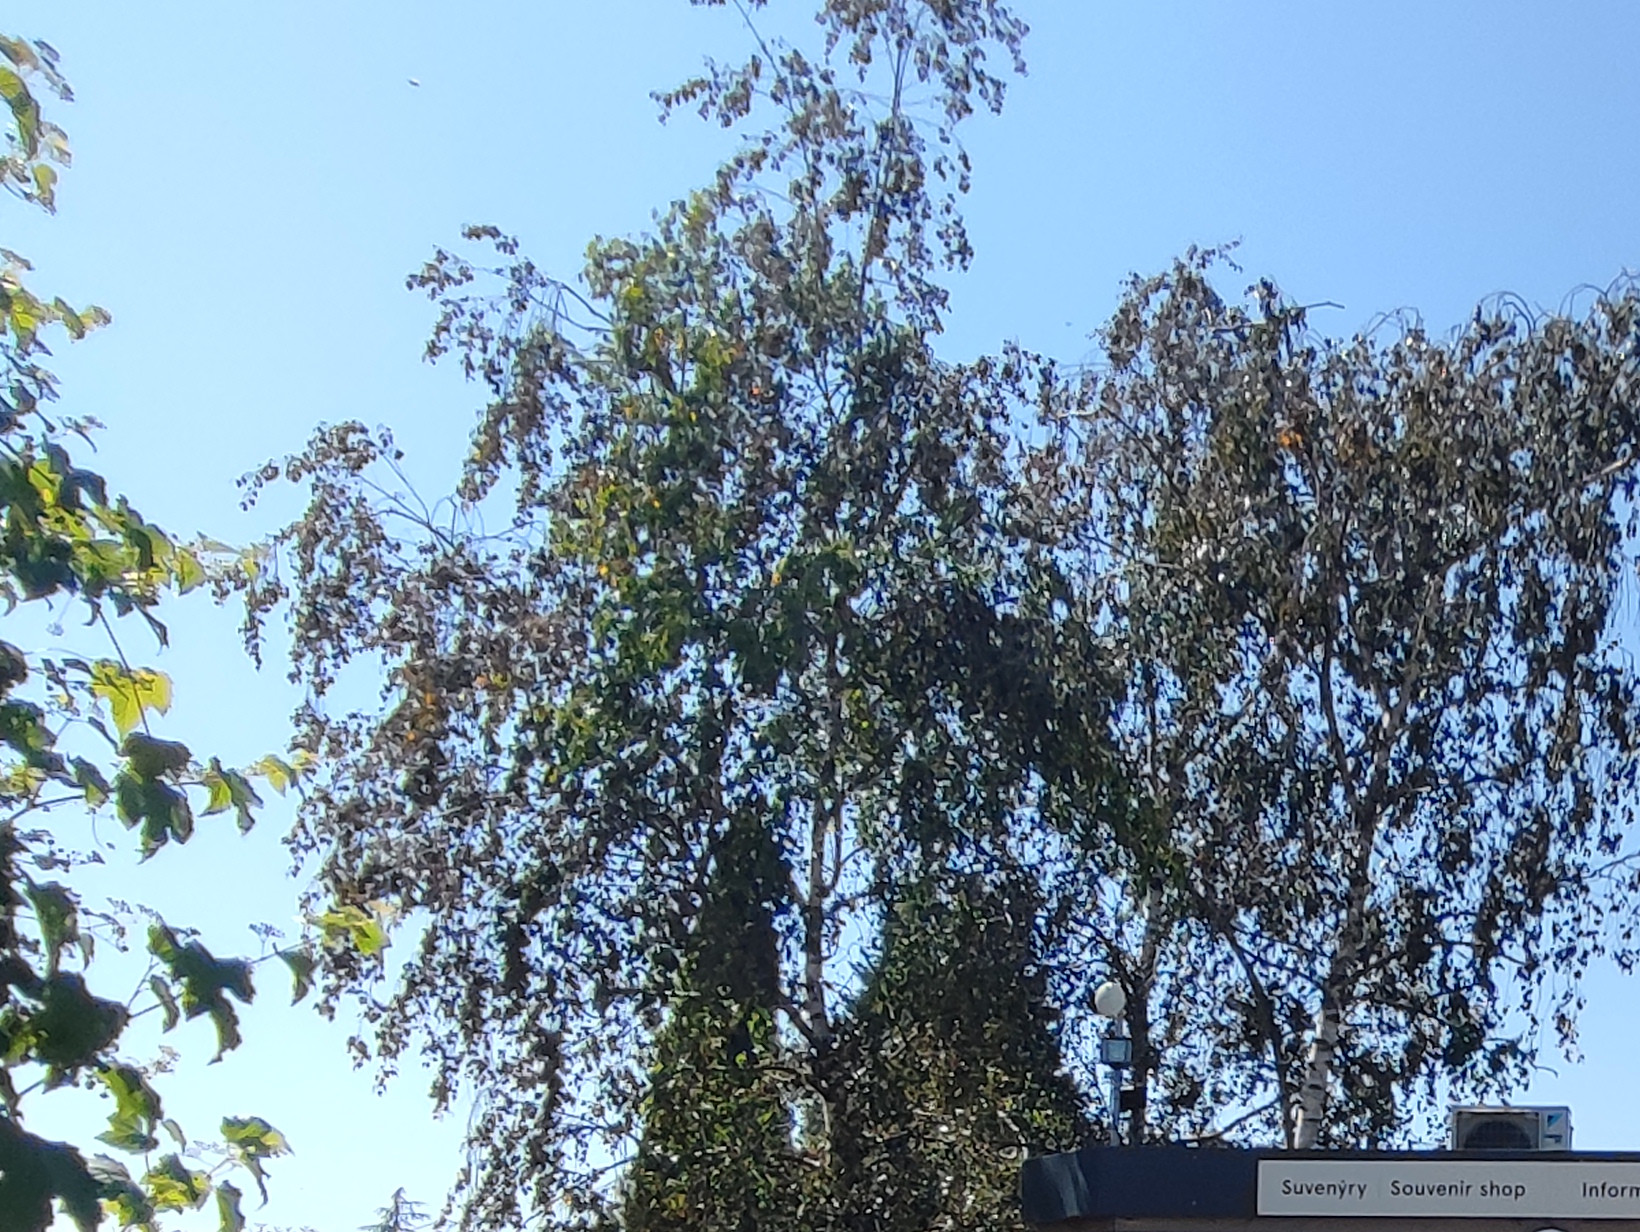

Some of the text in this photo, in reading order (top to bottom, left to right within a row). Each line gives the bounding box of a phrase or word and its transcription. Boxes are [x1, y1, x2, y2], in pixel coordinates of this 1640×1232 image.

[1281, 1179, 1367, 1199] Suvenýry
[1390, 1180, 1473, 1197] Souvenir
[1480, 1180, 1526, 1200] shop
